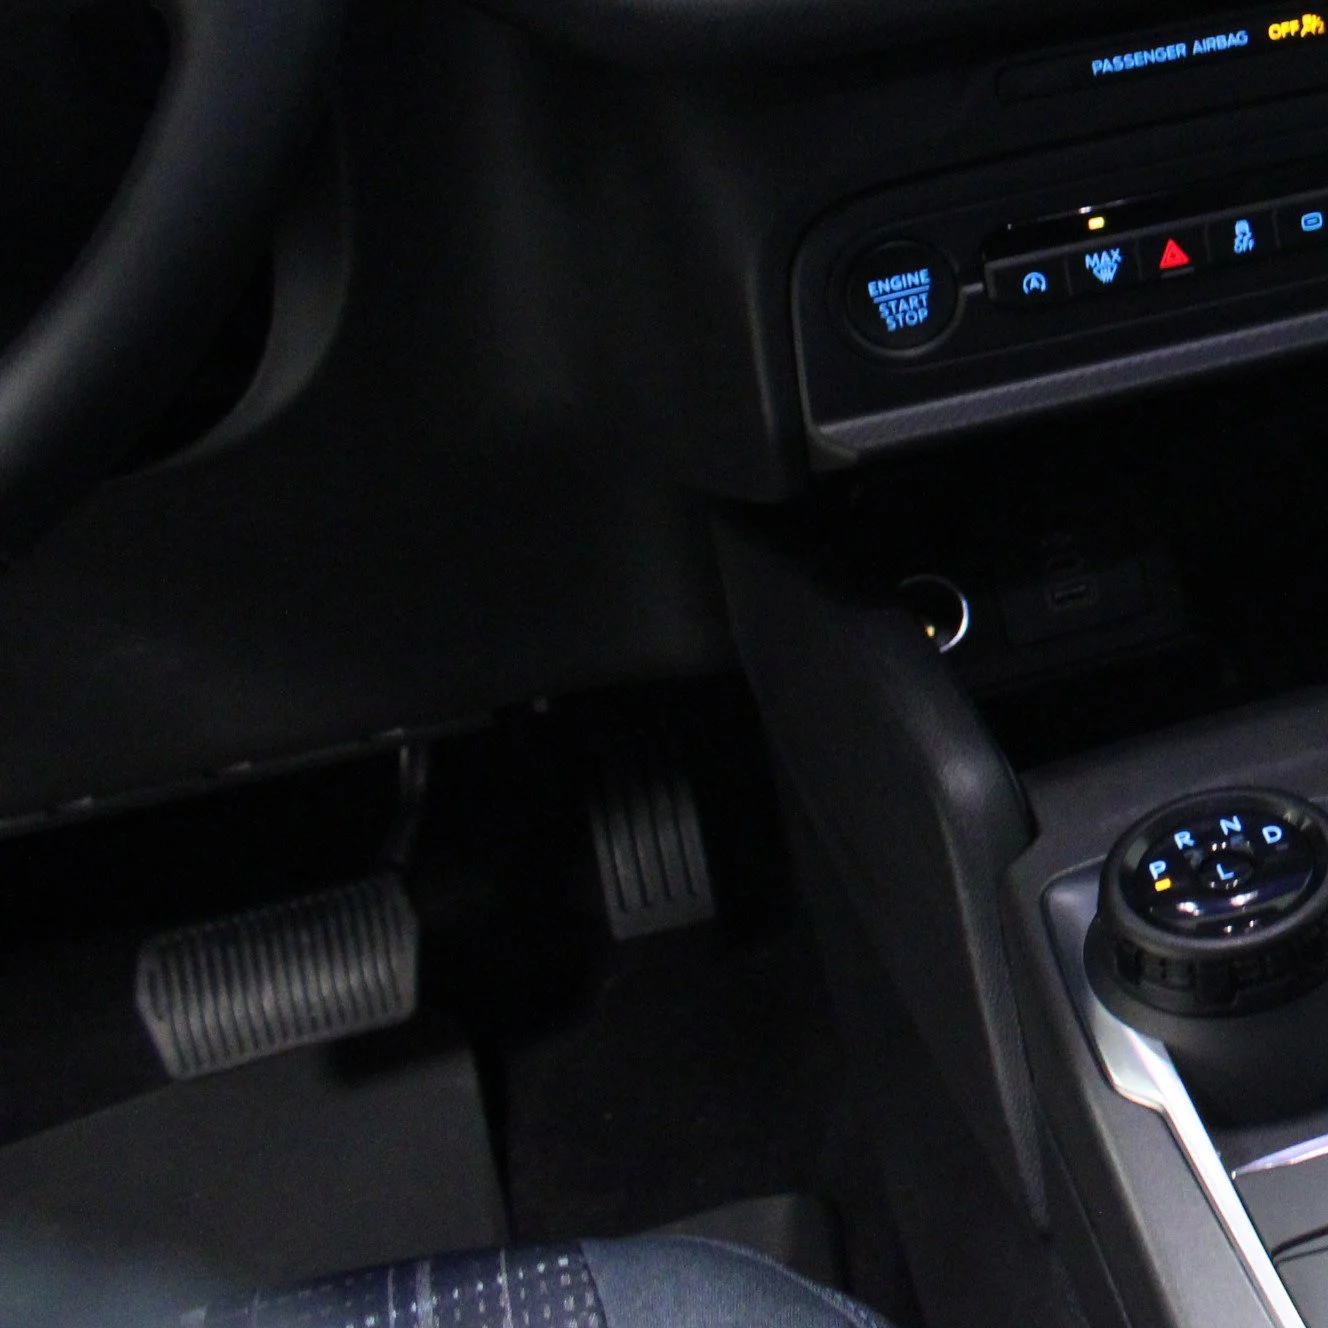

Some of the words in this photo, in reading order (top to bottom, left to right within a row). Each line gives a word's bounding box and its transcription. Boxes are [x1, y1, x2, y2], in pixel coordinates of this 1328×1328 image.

[1267, 18, 1299, 41] OFF
[1091, 43, 1187, 76] PASSENGER
[1192, 29, 1249, 56] AIRBAG
[1085, 247, 1123, 270] MAX
[868, 268, 931, 298] ENGINE
[879, 292, 928, 319] START
[886, 307, 928, 332] STOP
[1149, 859, 1167, 880] P
[1174, 830, 1195, 850] R
[1219, 815, 1242, 836] N
[1261, 824, 1283, 844] D
[1216, 863, 1234, 881] L
